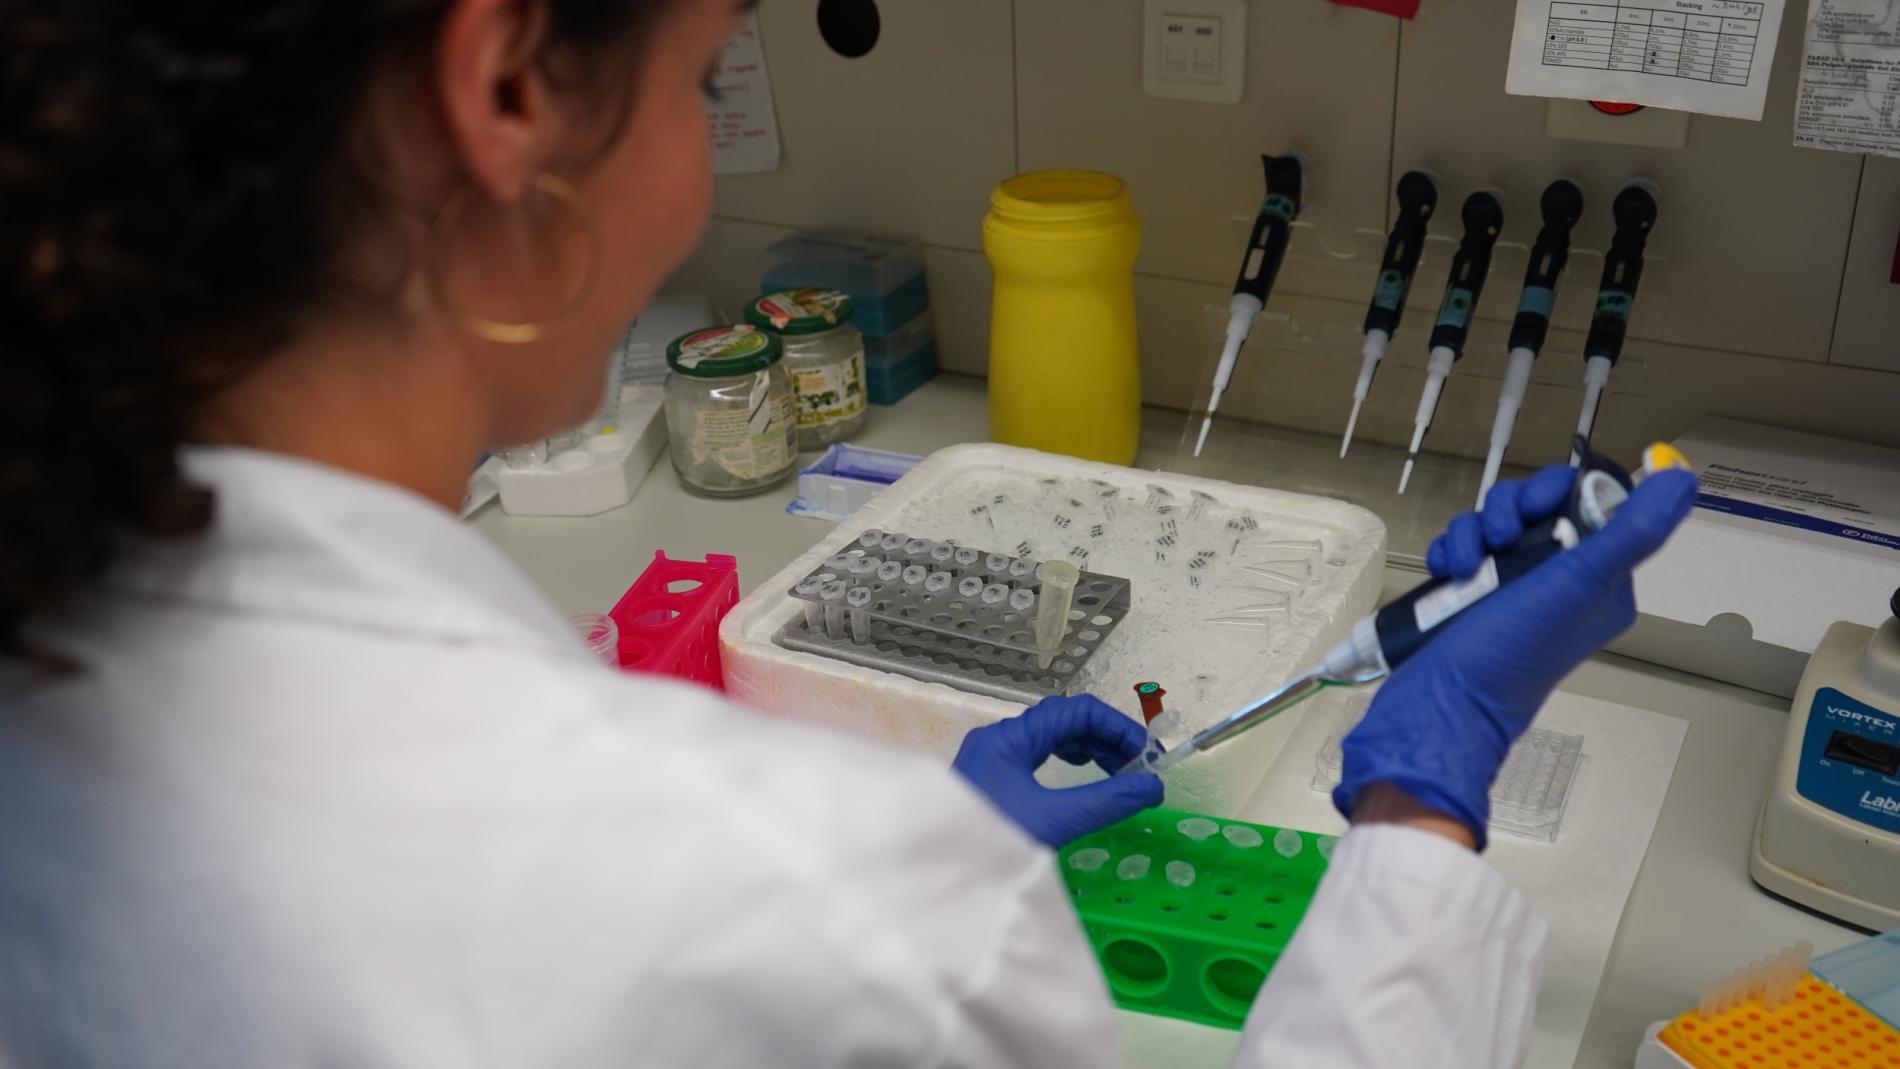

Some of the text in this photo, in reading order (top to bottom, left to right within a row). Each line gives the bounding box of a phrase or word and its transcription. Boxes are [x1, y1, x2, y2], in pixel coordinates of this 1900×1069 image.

[1676, 1, 1703, 11] Stacking
[1827, 705, 1896, 730] VORTEX
[1819, 759, 1831, 768] On
[1852, 768, 1865, 777] Off
